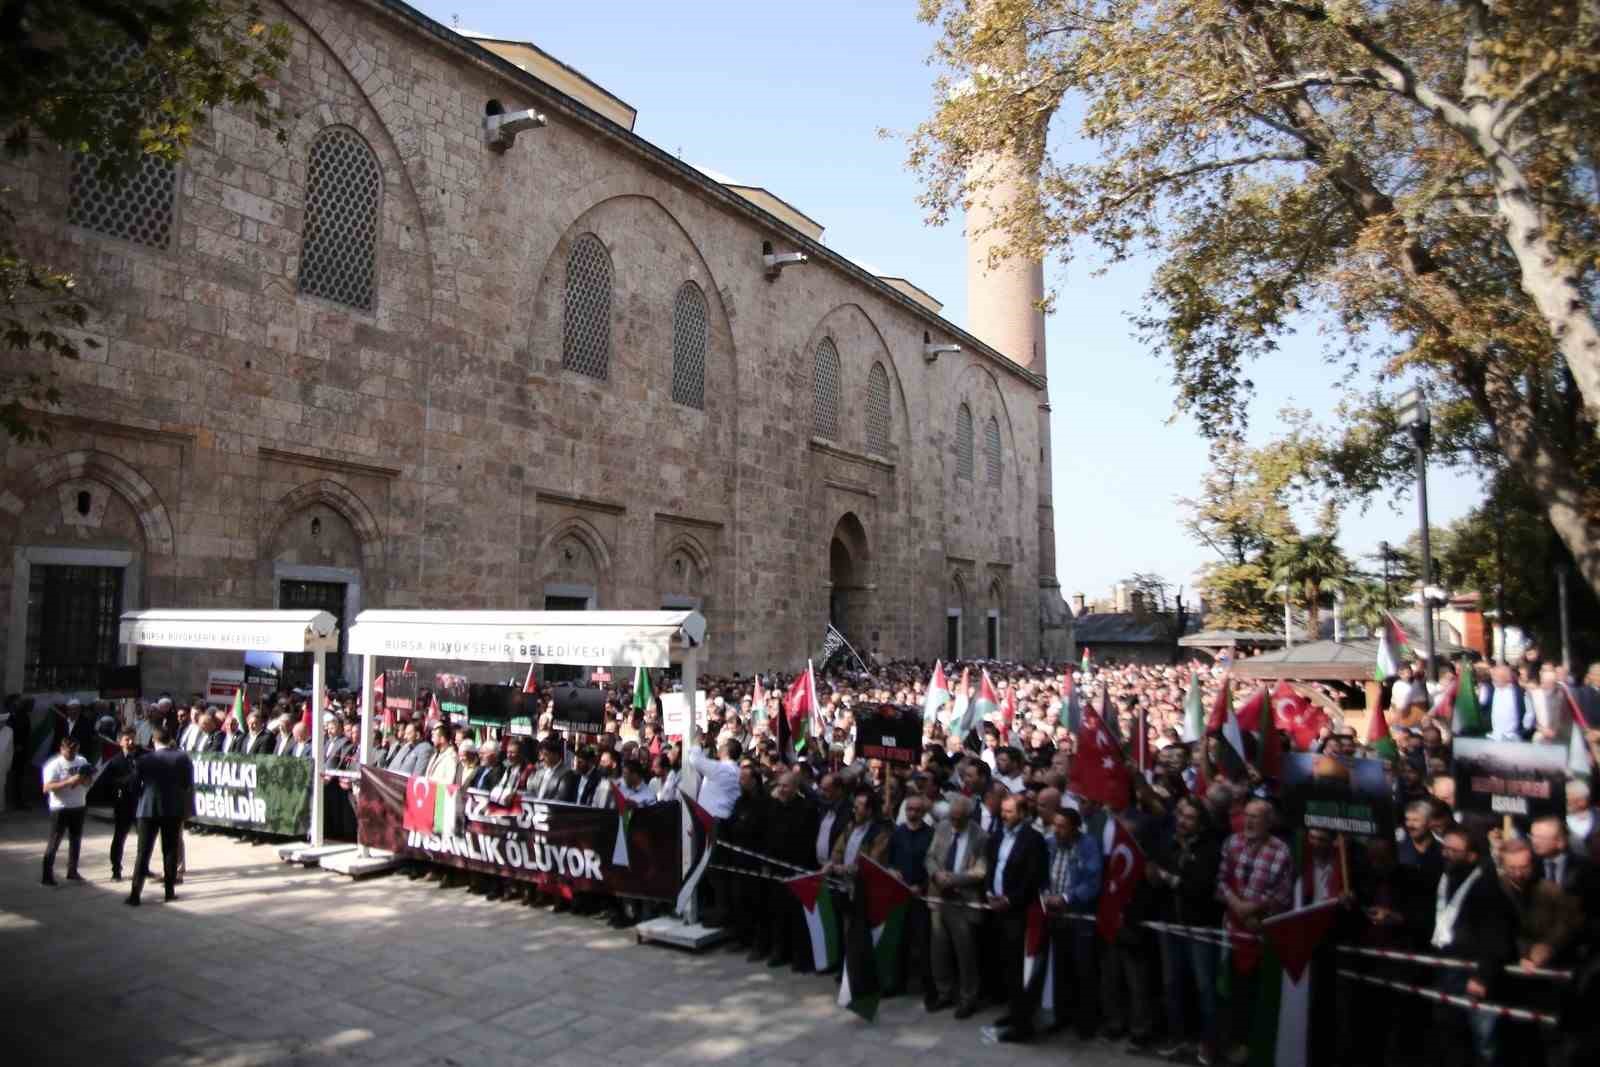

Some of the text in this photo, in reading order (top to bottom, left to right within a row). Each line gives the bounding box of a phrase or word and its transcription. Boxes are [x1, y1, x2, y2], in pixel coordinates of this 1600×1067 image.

[384, 639, 423, 650] BURSA
[211, 760, 257, 788] HALKI
[194, 788, 267, 823] DEĞİLDİR
[504, 832, 604, 881] ÖLÜYOR
